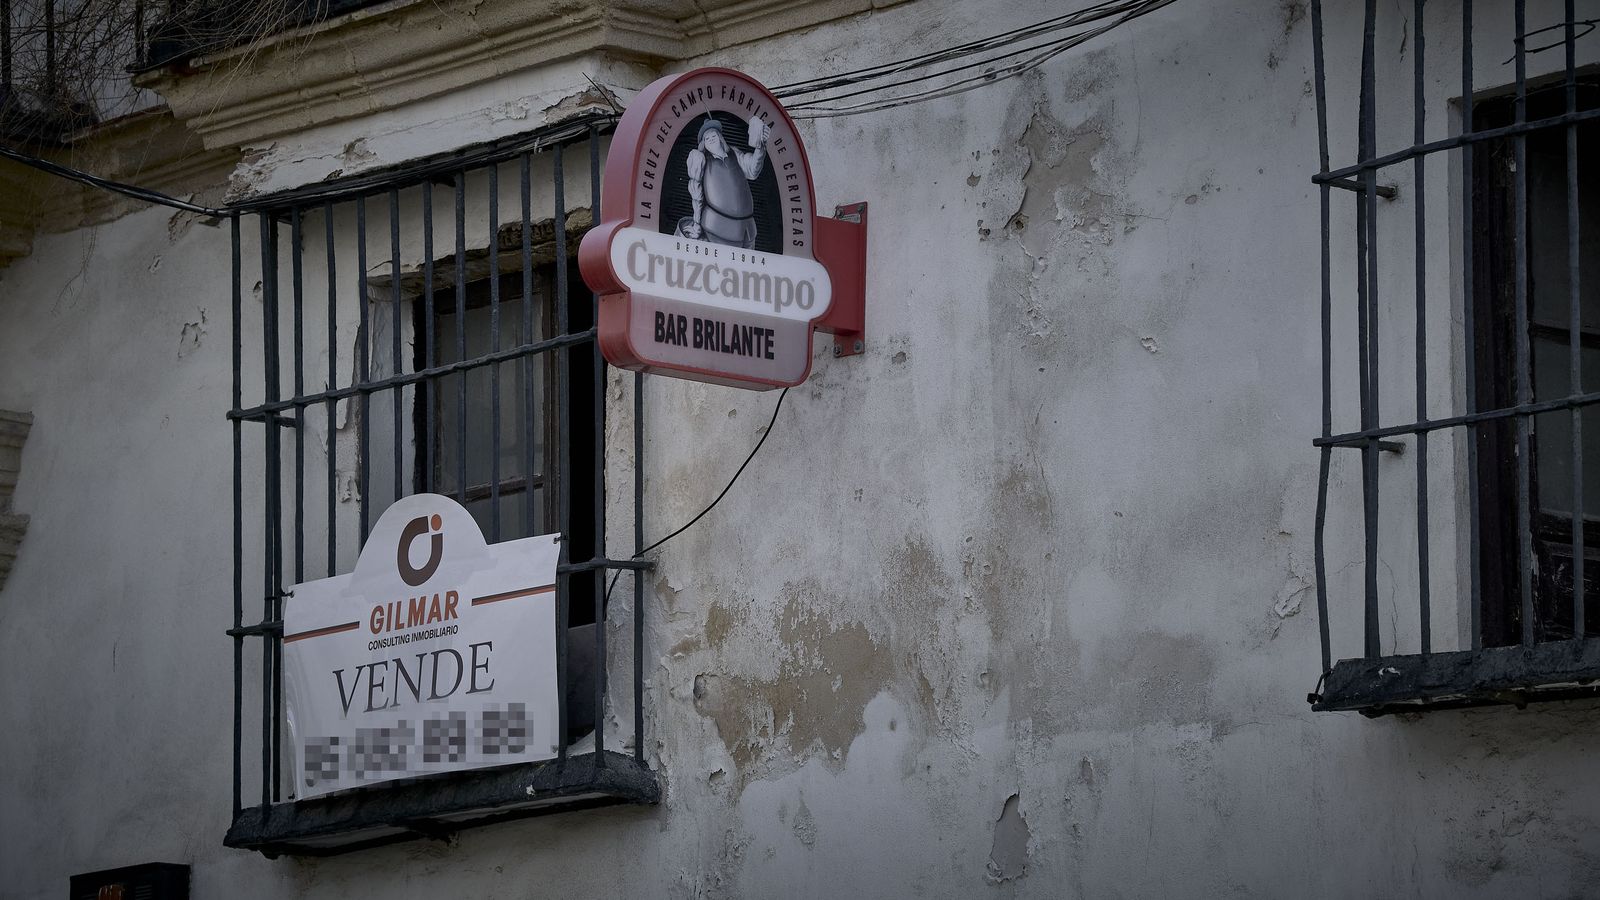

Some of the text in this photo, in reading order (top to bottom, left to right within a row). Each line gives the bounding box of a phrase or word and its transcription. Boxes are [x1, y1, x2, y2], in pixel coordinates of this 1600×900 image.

[671, 85, 713, 118] CAMPO
[656, 120, 672, 143] DEL
[774, 137, 787, 154] DE
[642, 149, 660, 190] CRUZ
[640, 201, 652, 219] LA
[783, 162, 804, 247] CERVEZAS
[676, 242, 765, 266] DESDE 1904
[626, 239, 815, 313] Cruzcampo
[654, 310, 775, 360] BAR BRILANTE
[369, 590, 460, 635] GILMAR
[368, 624, 459, 652] CONSULTING INMOBILIARIO
[332, 641, 495, 719] VENDE
